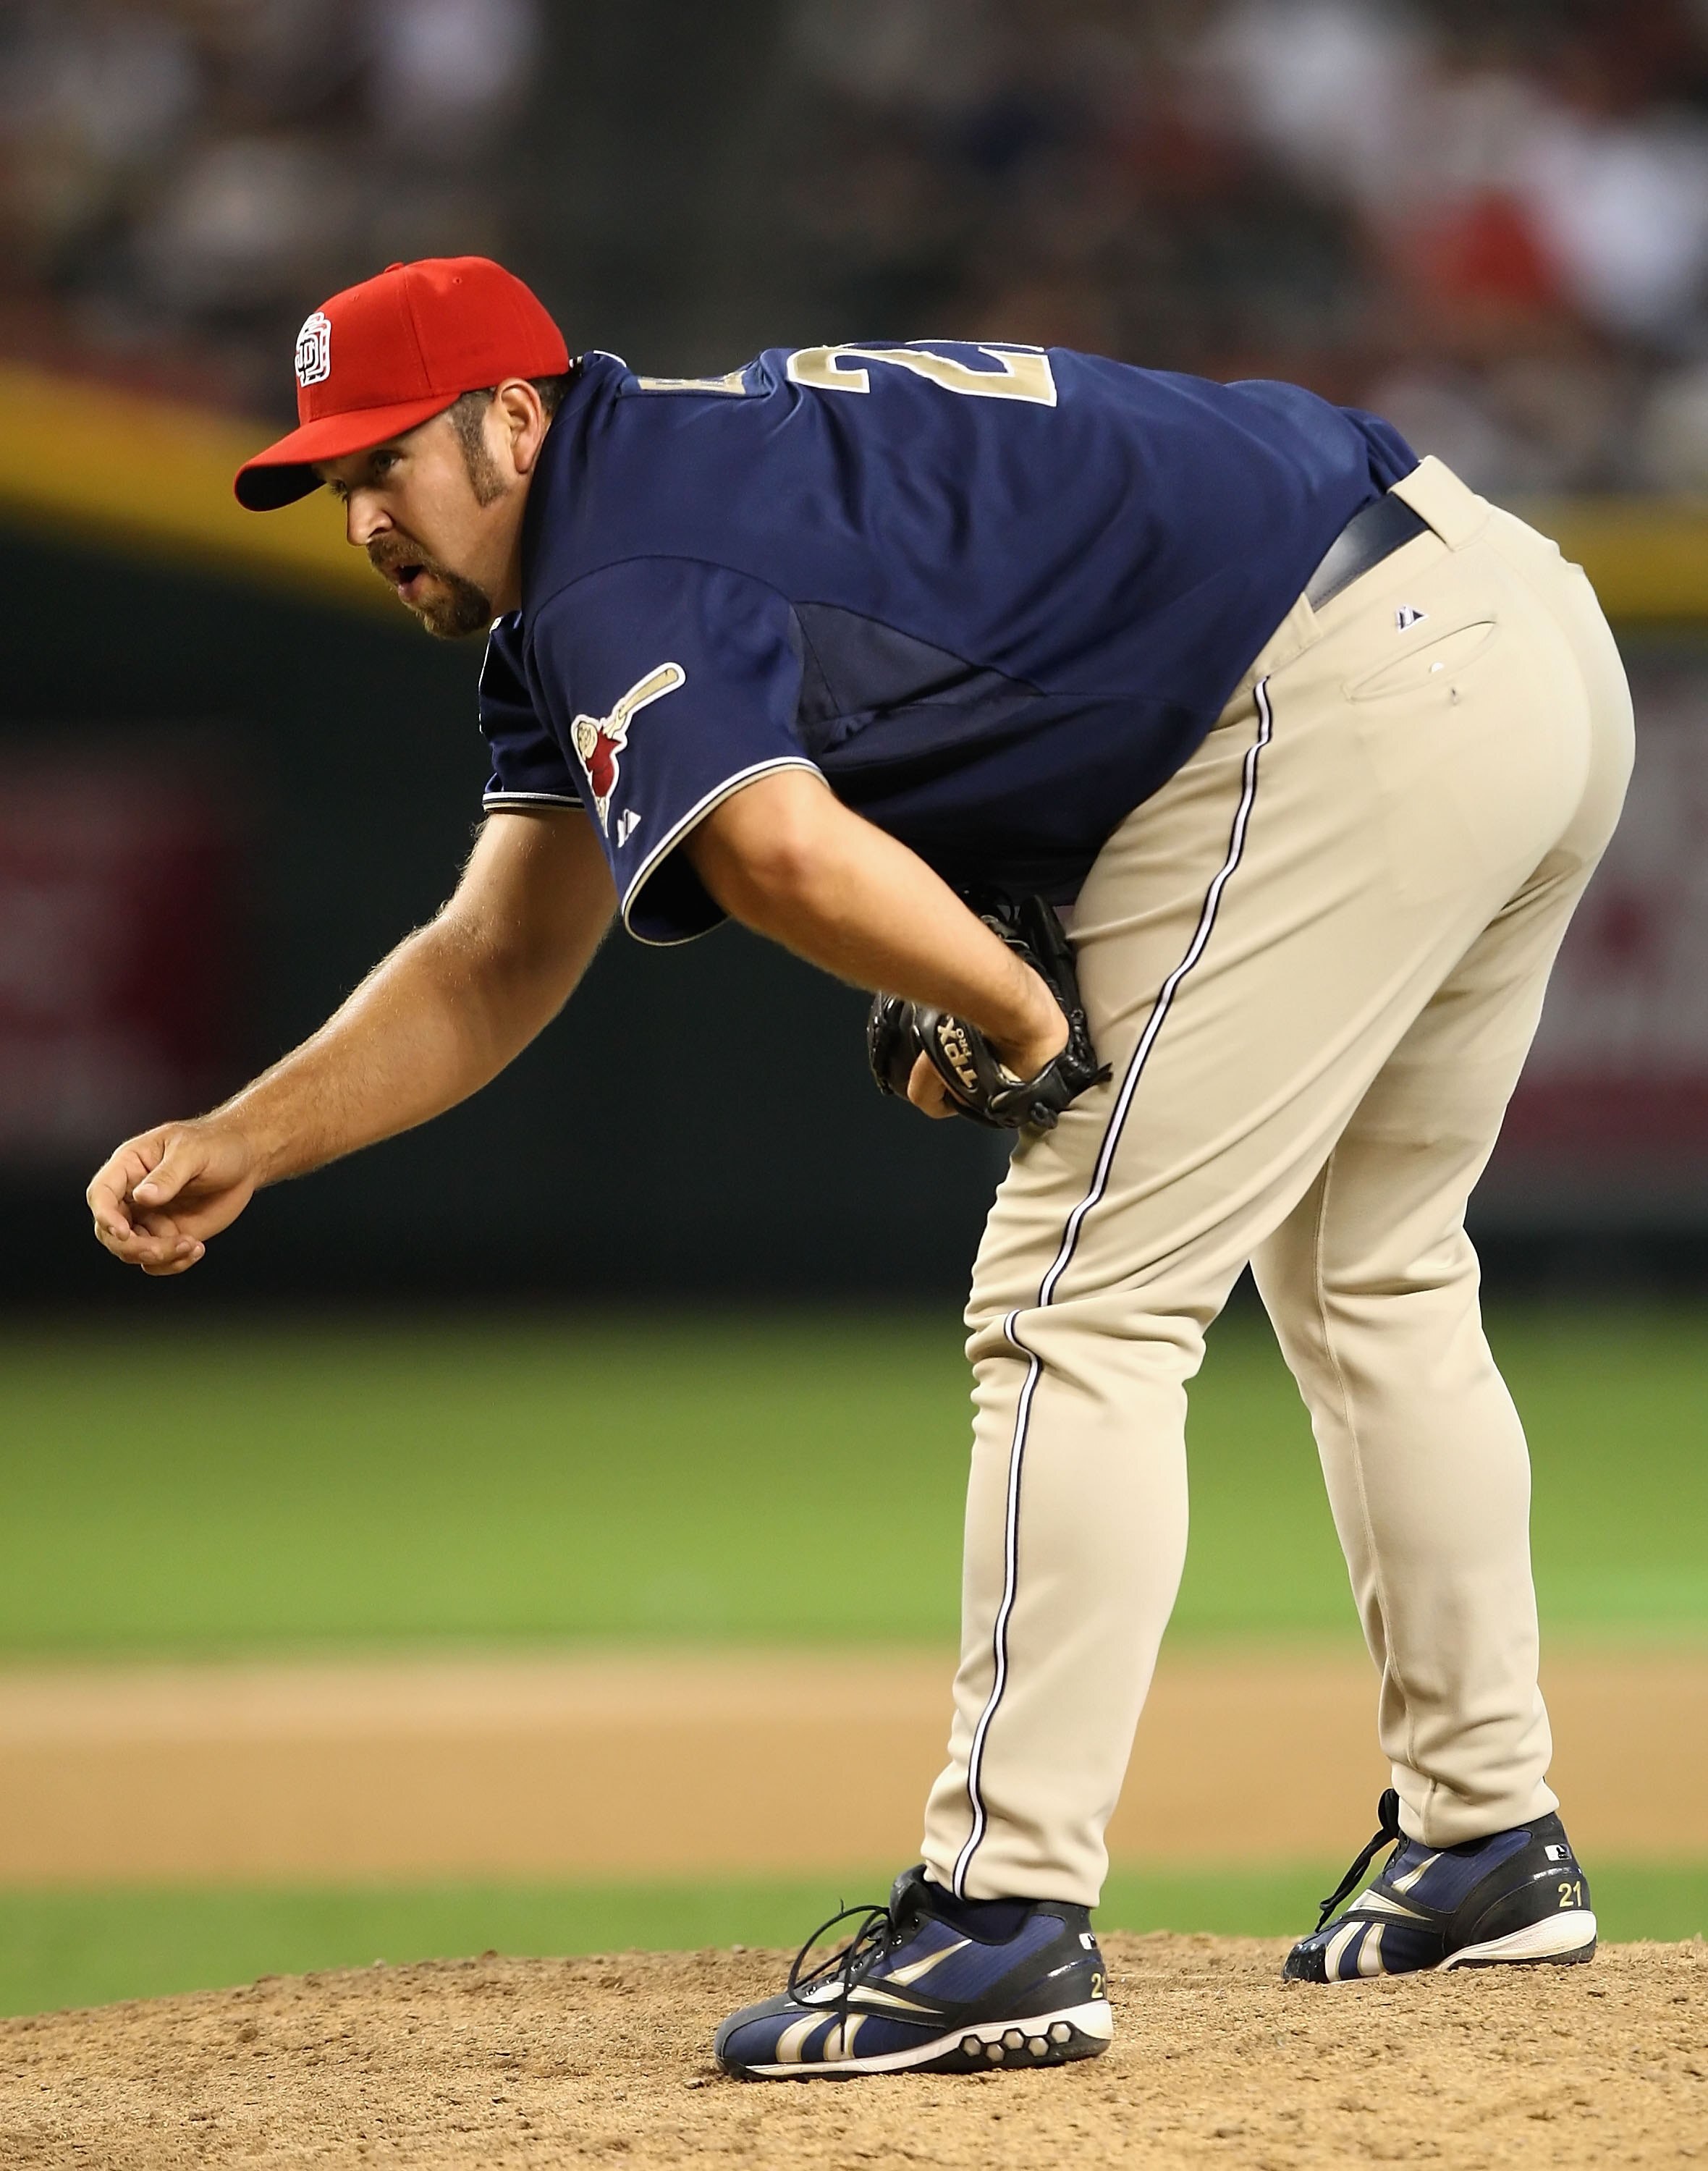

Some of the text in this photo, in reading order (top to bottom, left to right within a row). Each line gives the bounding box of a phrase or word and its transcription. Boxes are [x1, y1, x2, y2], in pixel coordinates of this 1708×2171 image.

[937, 1017, 978, 1088] TPX
[955, 1028, 972, 1056] PRO
[1558, 1881, 1582, 1908] 21
[1091, 1973, 1106, 1999] 2
